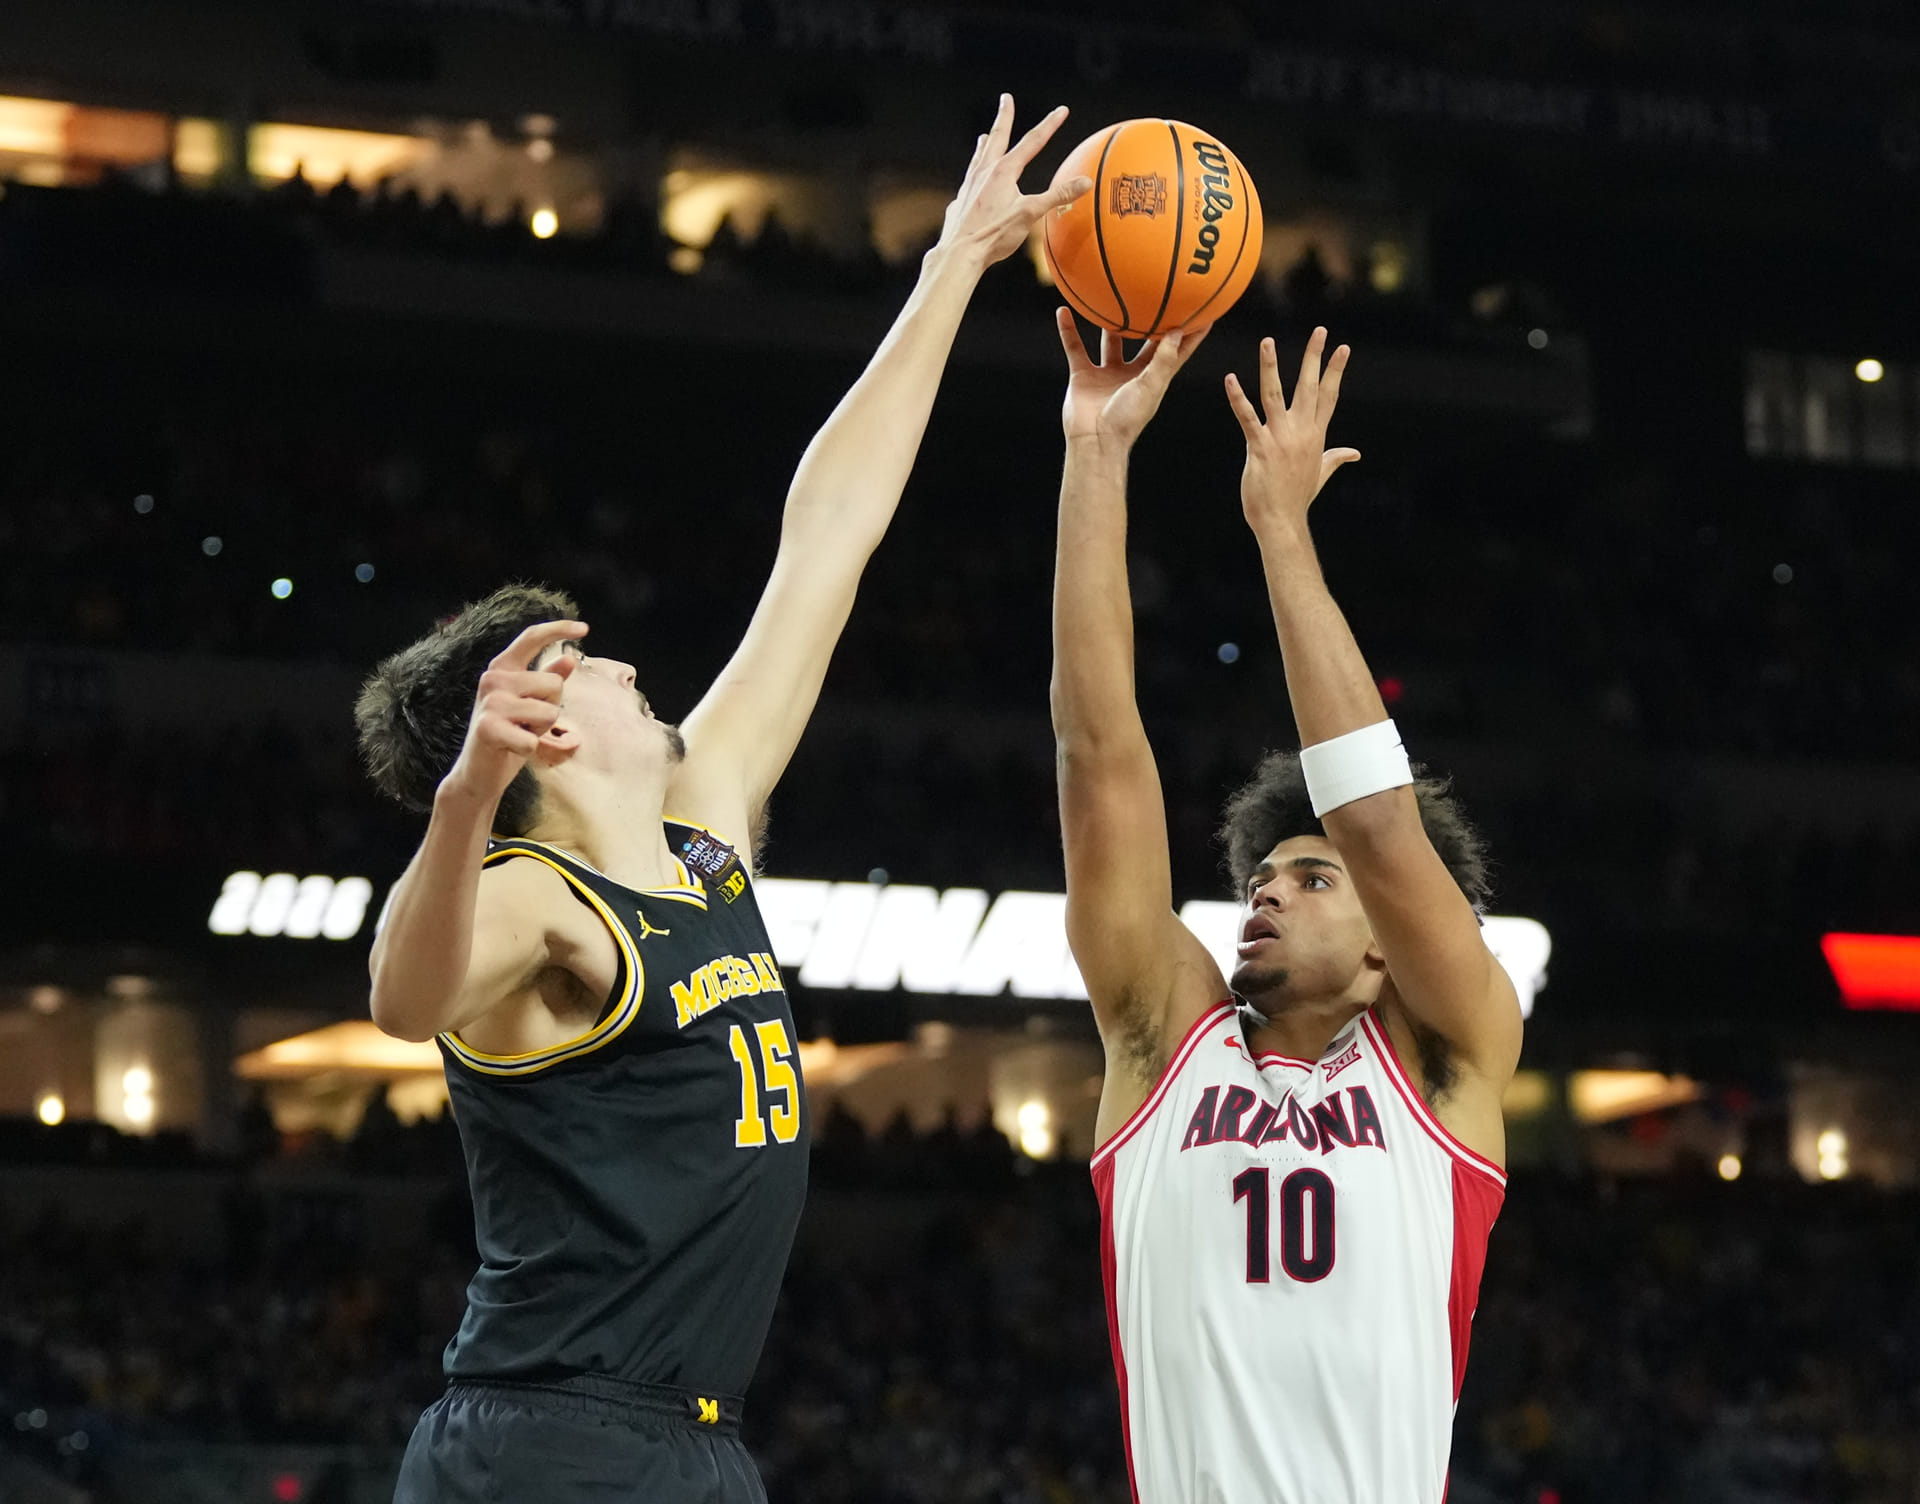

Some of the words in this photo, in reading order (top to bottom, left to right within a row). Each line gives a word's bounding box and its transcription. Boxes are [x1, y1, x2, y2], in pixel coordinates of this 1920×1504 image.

[1187, 140, 1234, 276] Wilson
[685, 838, 710, 865] FINAL
[704, 849, 729, 875] FOUR
[752, 879, 1090, 1000] FINA
[728, 1018, 800, 1149] 15
[1233, 1166, 1336, 1285] 10
